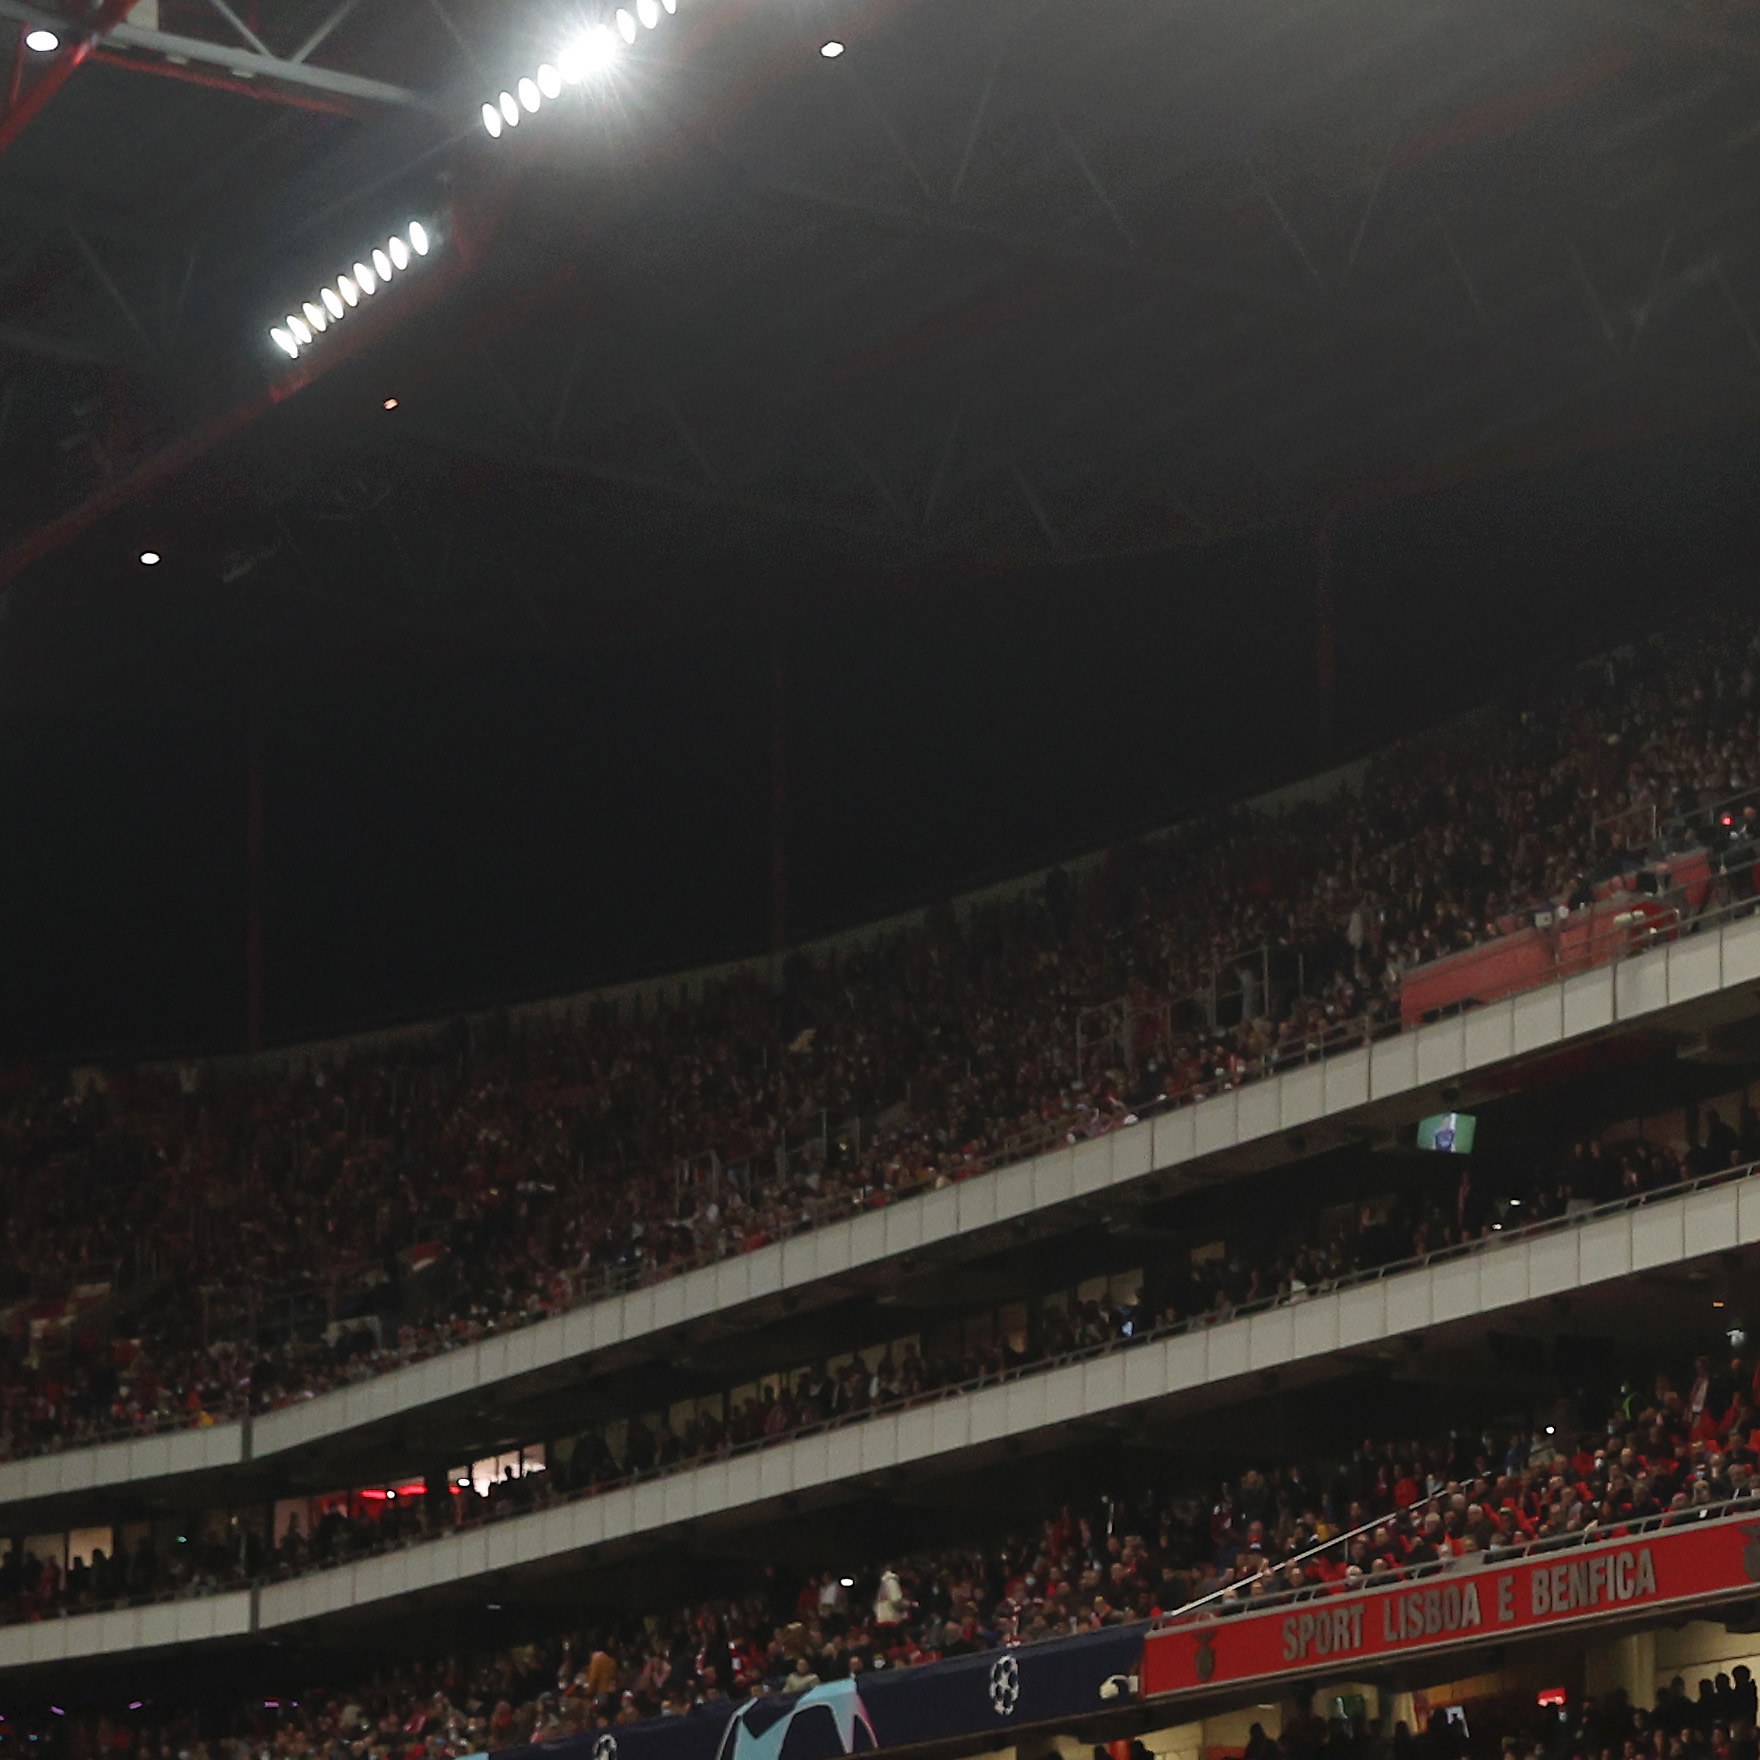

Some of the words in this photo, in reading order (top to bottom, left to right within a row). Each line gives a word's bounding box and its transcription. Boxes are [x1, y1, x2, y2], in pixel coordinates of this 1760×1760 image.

[1282, 1604, 1365, 1661] SPORT
[1384, 1583, 1482, 1642] LISBOA
[1499, 1577, 1515, 1622] E
[1532, 1549, 1657, 1615] BENFICA
